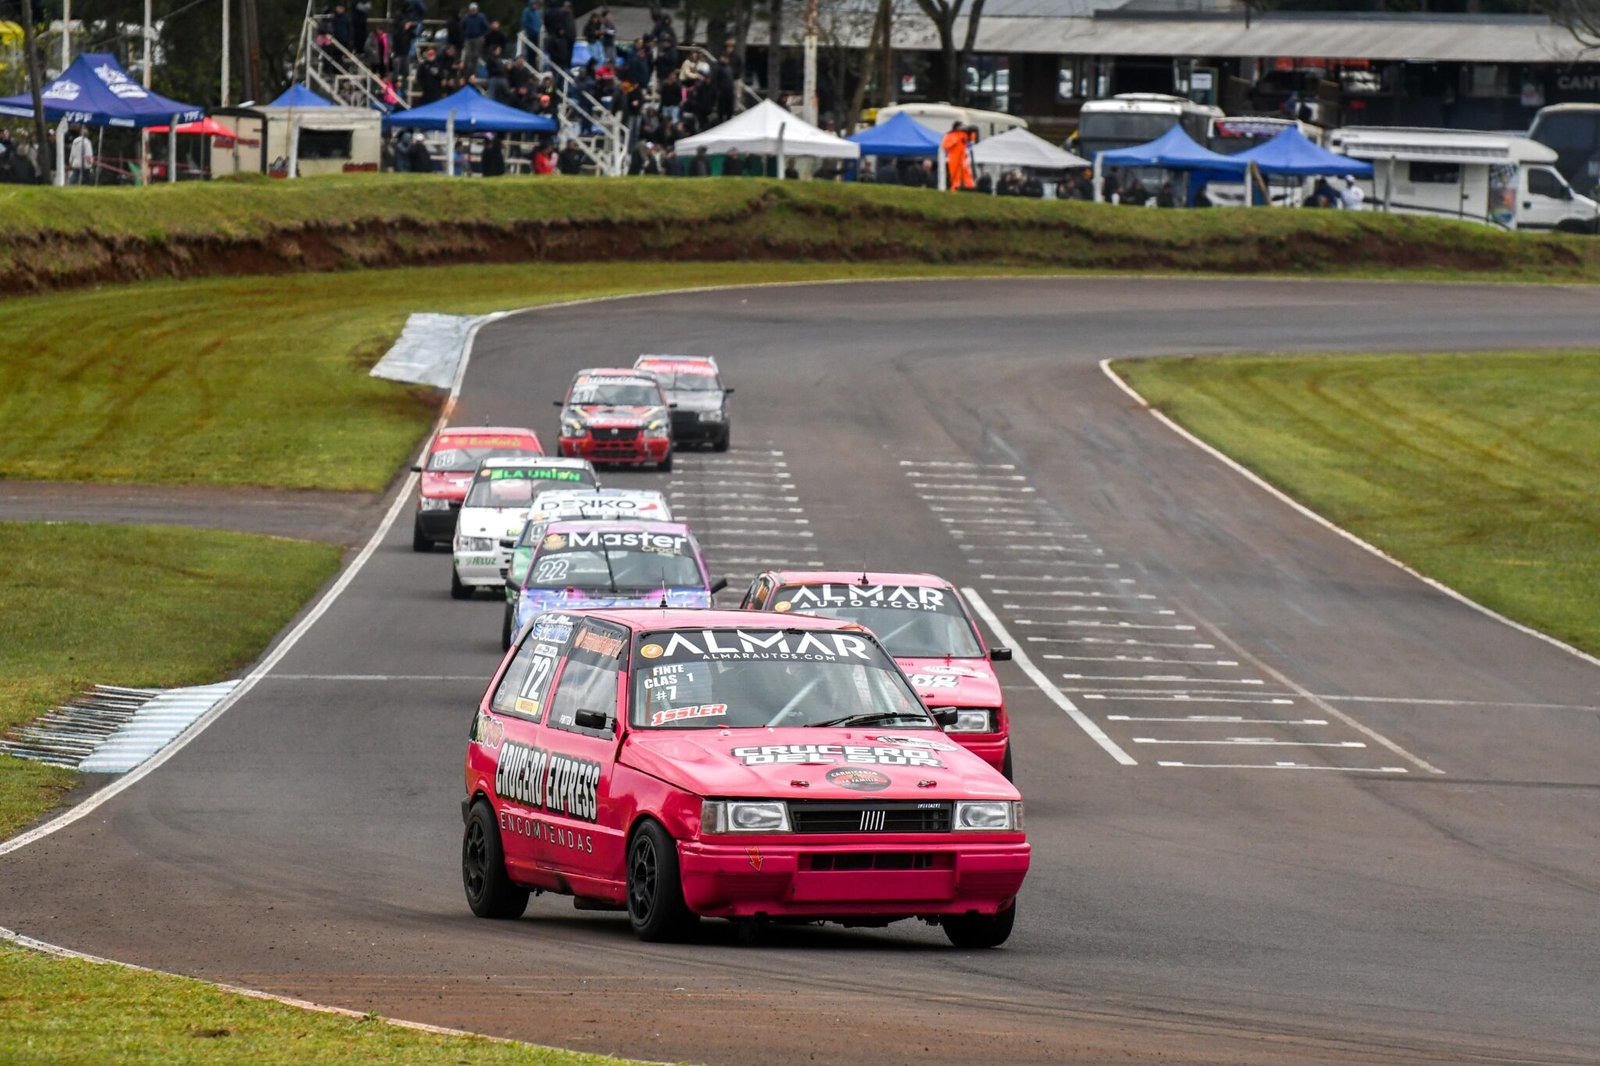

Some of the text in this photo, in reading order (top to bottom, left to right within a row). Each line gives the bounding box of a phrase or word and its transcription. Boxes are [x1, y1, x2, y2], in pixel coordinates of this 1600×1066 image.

[569, 531, 688, 549] Master
[537, 559, 570, 584] 22
[790, 584, 945, 607] ALMAR
[800, 600, 937, 612] AUTOS.COM
[662, 629, 872, 660] ALMAR
[702, 652, 836, 662] ALMARAUTOS.COM
[652, 664, 685, 677] FINTE
[644, 672, 694, 690] CLAS 1
[655, 685, 678, 701] #7
[732, 744, 930, 759] CRUCERO
[744, 753, 944, 768] DEL SUR
[494, 741, 600, 821] CRUCERO EXPRESS
[500, 811, 593, 853] ENCOMIENDAS
